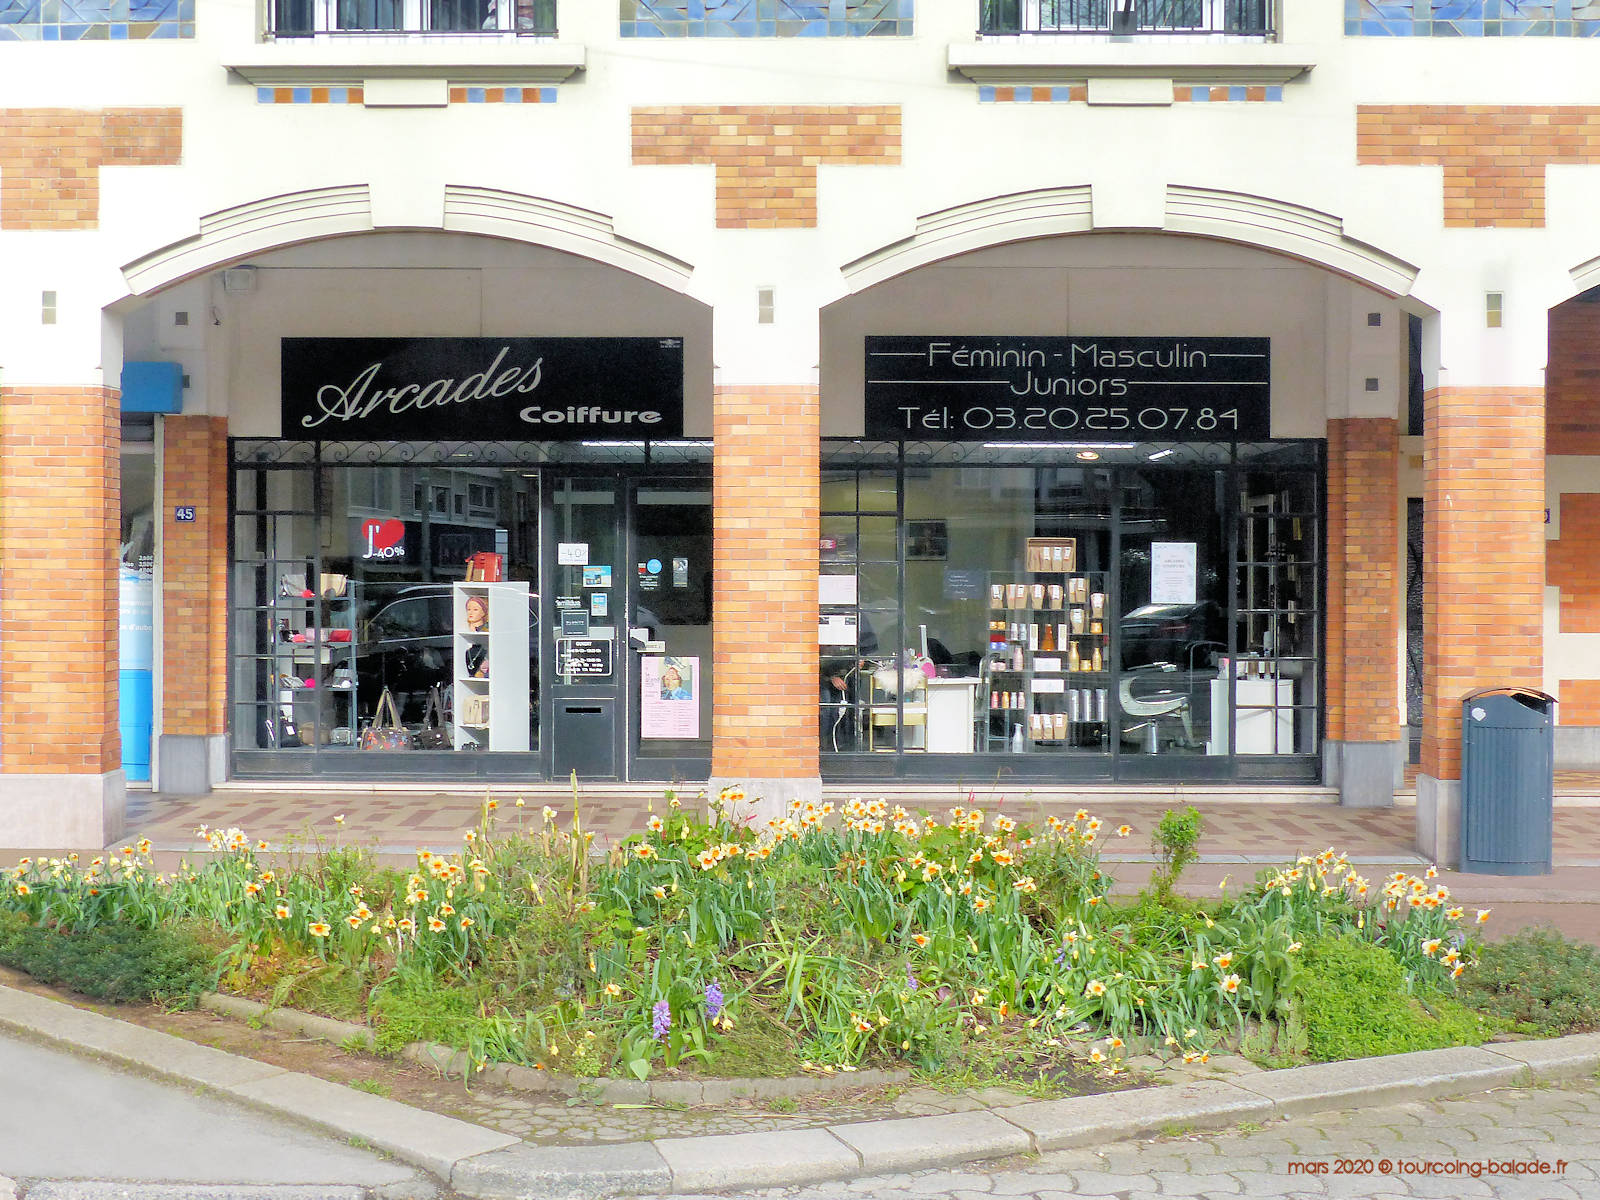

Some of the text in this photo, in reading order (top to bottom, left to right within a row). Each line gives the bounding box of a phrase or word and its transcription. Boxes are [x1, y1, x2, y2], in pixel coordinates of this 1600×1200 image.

[929, 343, 1046, 367] Féminin
[1071, 343, 1207, 367] Masculin
[301, 346, 544, 428] Arcades
[1010, 370, 1128, 396] Juniors
[519, 405, 663, 424] Coiffure
[897, 406, 1238, 431] Tél: 03.20.25.07.84
[177, 508, 193, 520] 45
